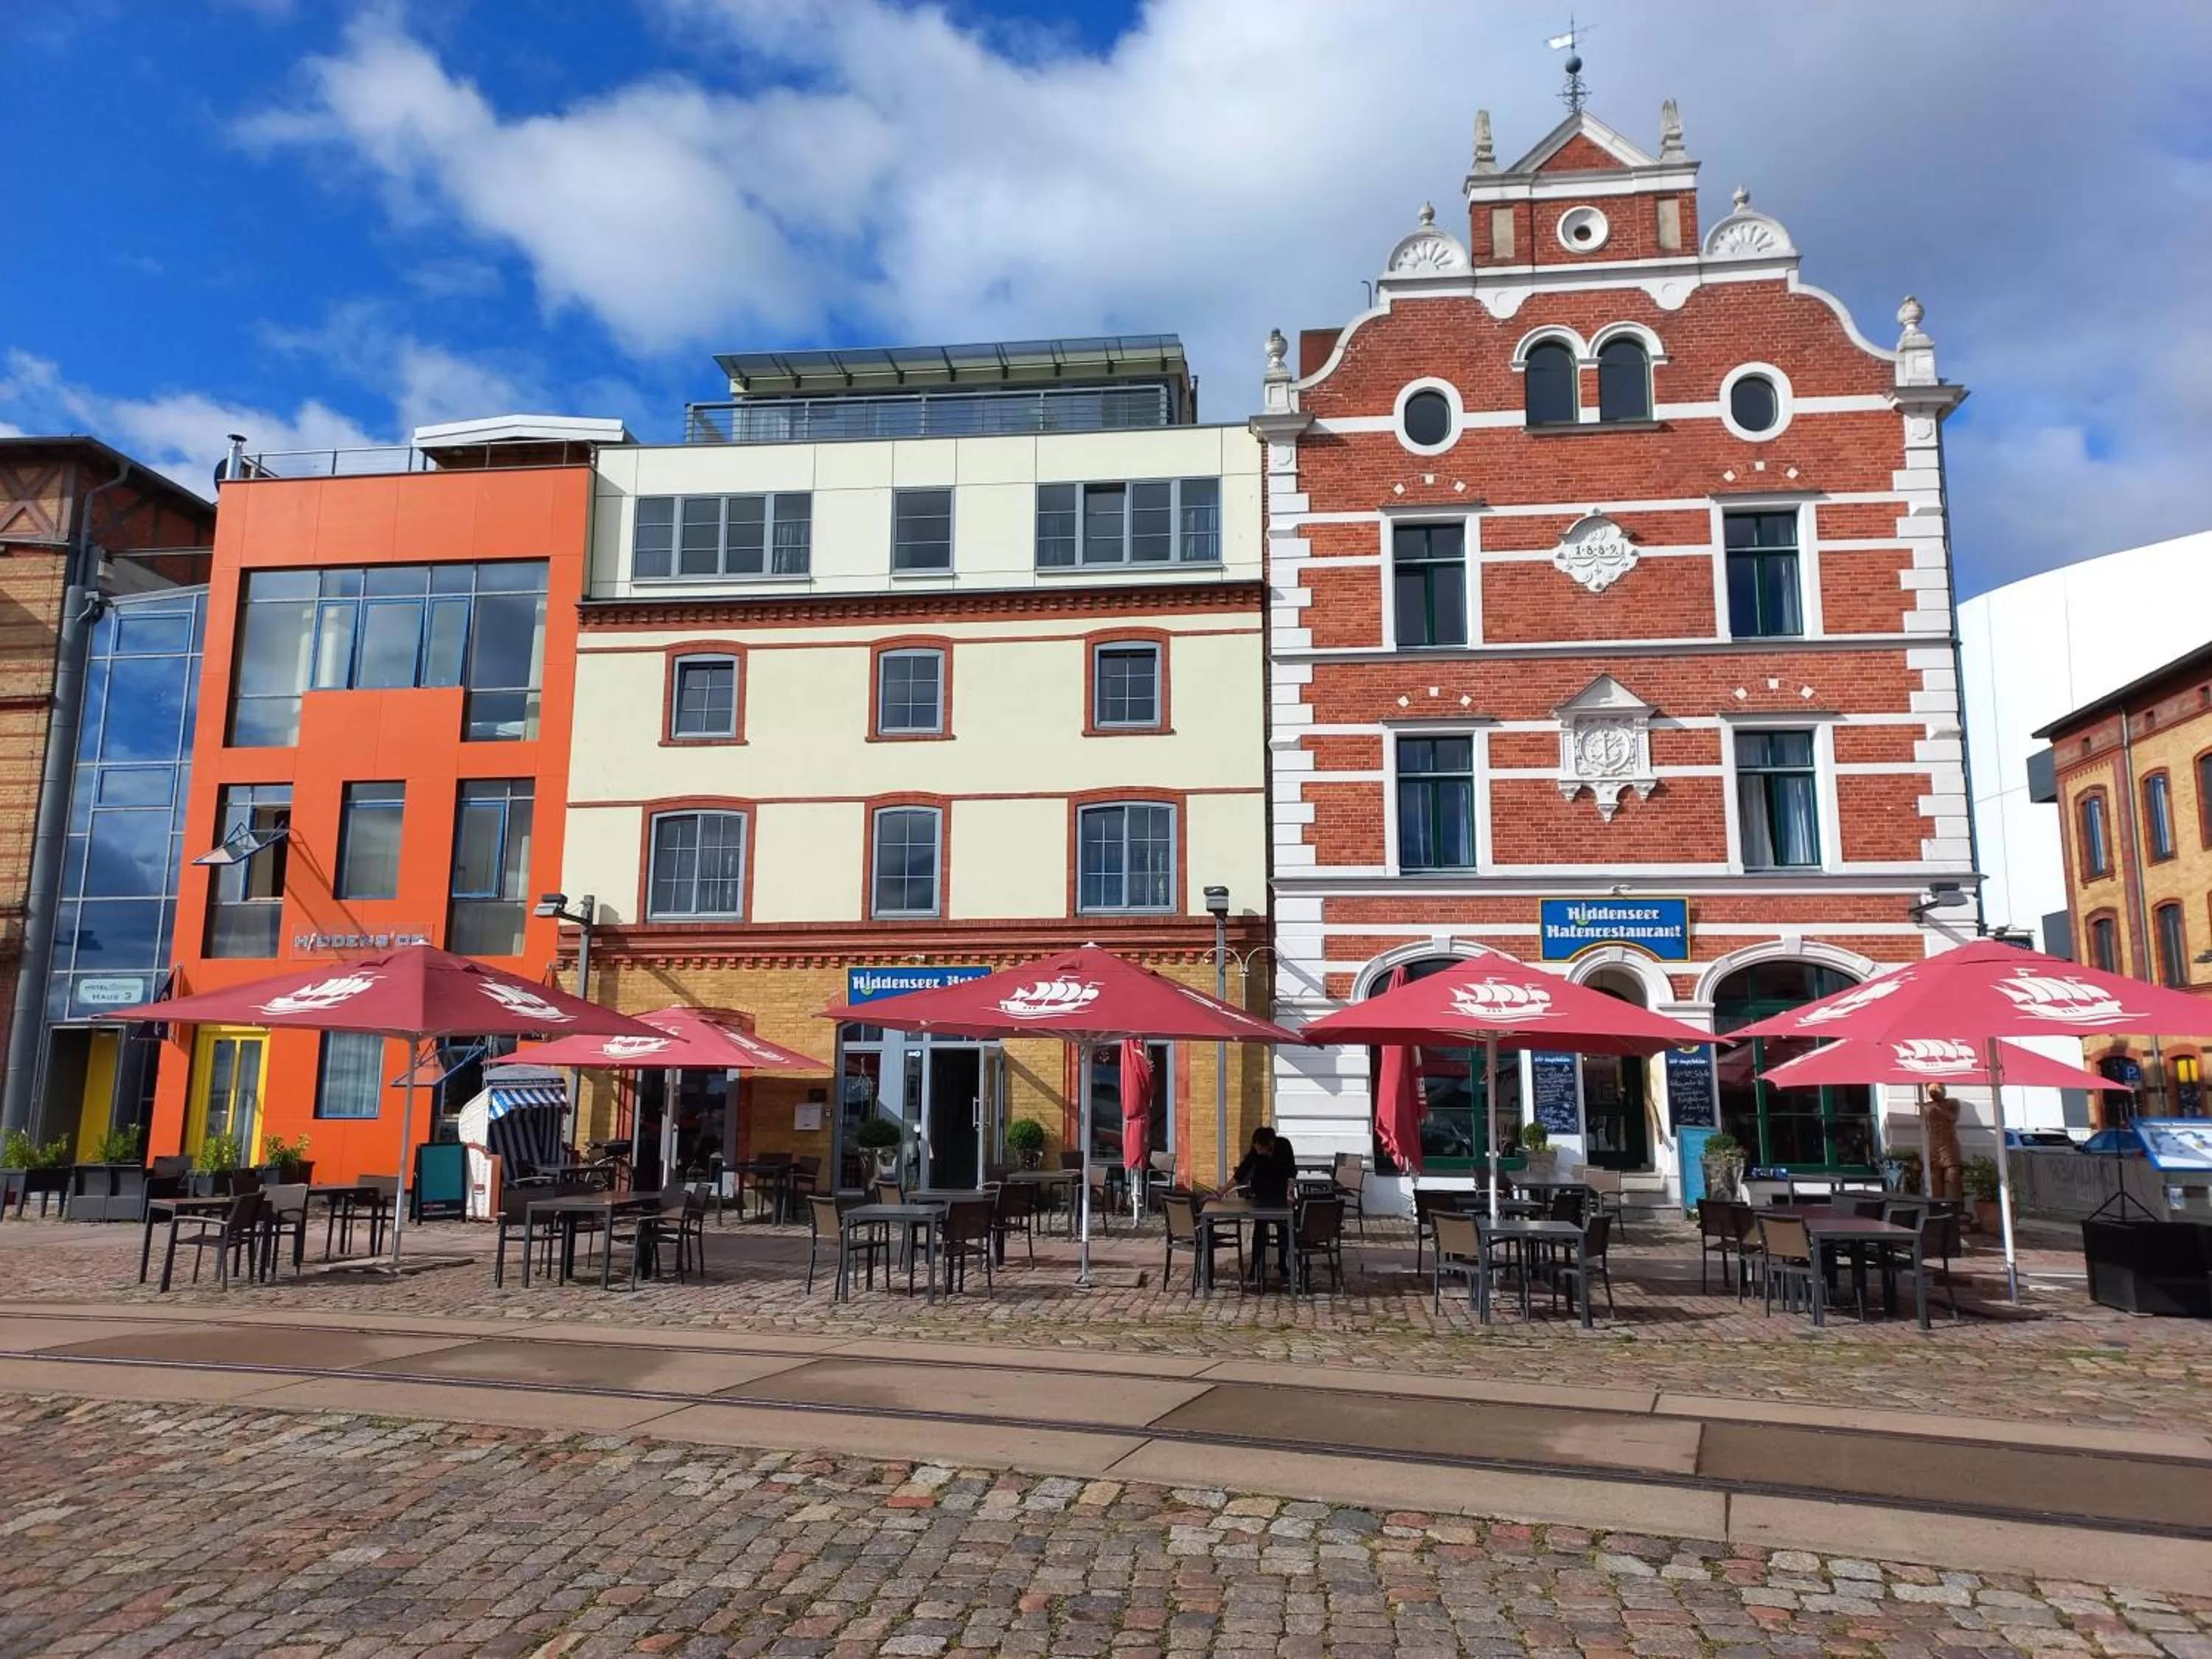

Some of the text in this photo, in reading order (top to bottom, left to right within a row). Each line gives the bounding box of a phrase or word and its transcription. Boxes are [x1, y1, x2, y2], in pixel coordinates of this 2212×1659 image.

[1566, 902, 1660, 920] Hiddenseer
[1545, 924, 1681, 939] Hafenrestaurant
[852, 972, 940, 990] Hiddenseer
